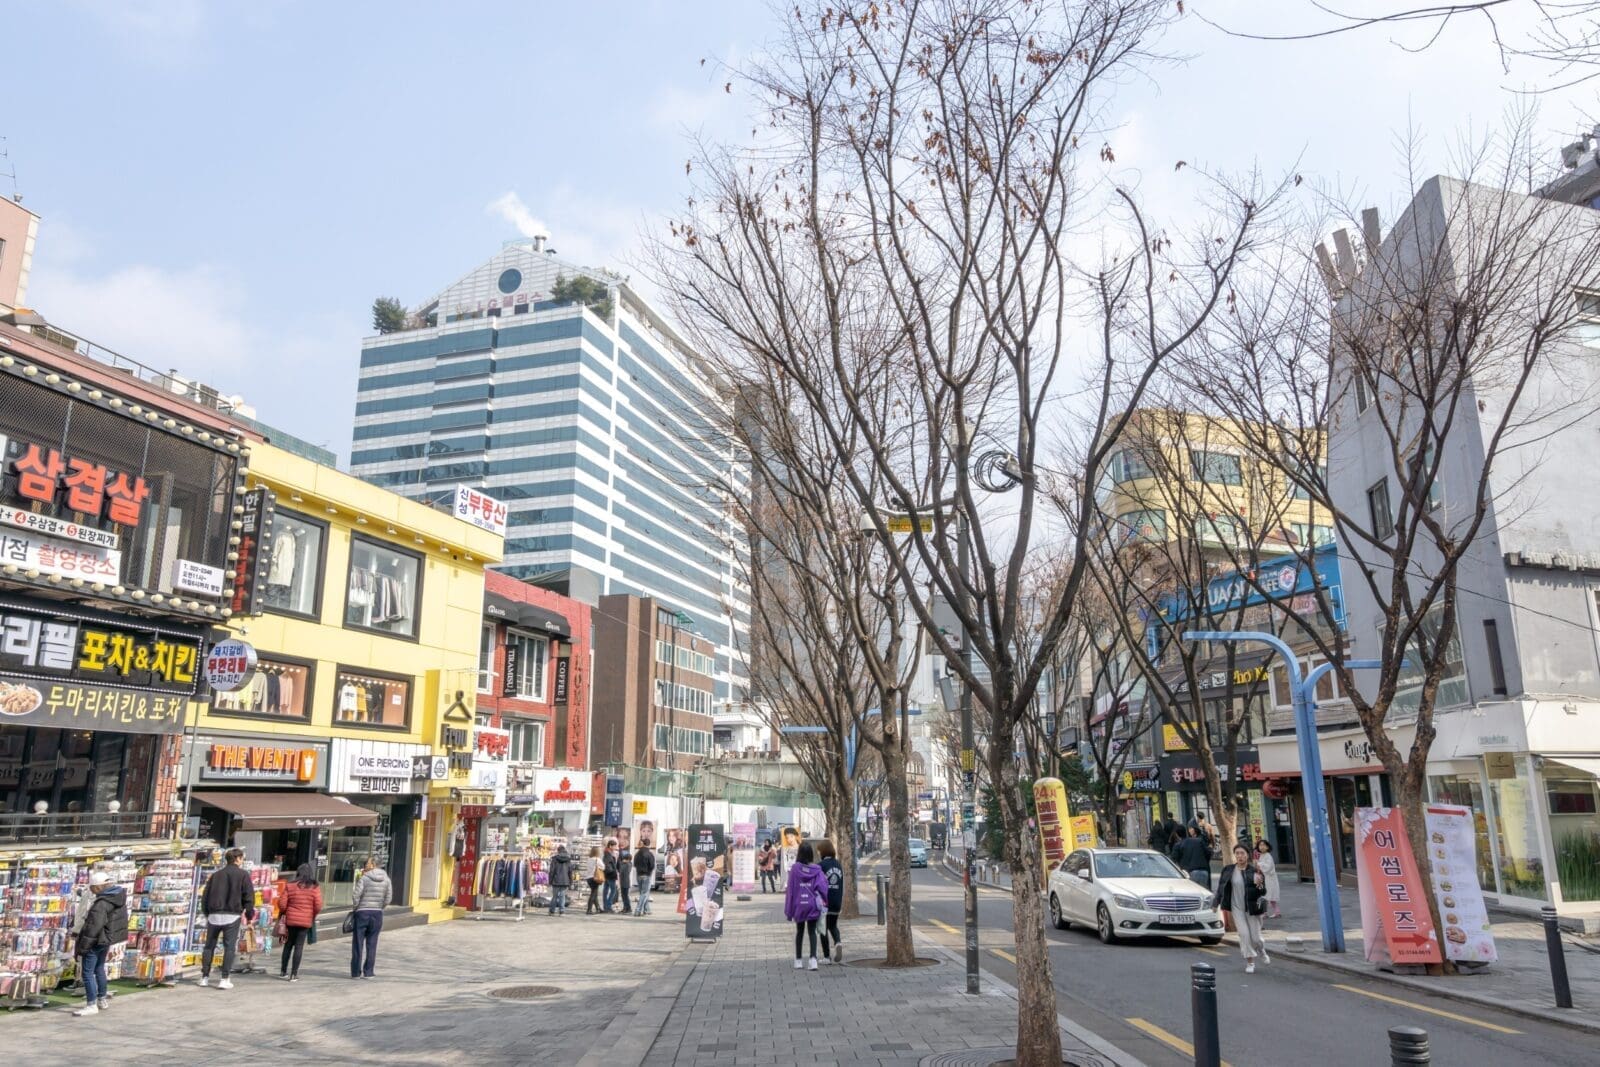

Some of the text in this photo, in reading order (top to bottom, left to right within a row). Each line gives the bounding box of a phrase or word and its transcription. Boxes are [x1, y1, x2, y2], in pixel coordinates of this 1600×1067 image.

[15, 443, 150, 527] 삼겹살
[469, 491, 506, 526] 부동산
[37, 543, 117, 577] 촬영장소
[0, 615, 198, 684] 리필 포차&치킨
[207, 656, 247, 674] 무한리필
[506, 648, 516, 689] TIRAMISU
[557, 661, 567, 696] COFFEE
[211, 744, 301, 770] THE VENTI
[358, 756, 410, 769] ONE PIERCING
[361, 776, 401, 793] 원피어싱
[1373, 829, 1417, 931] 어썸로즈
